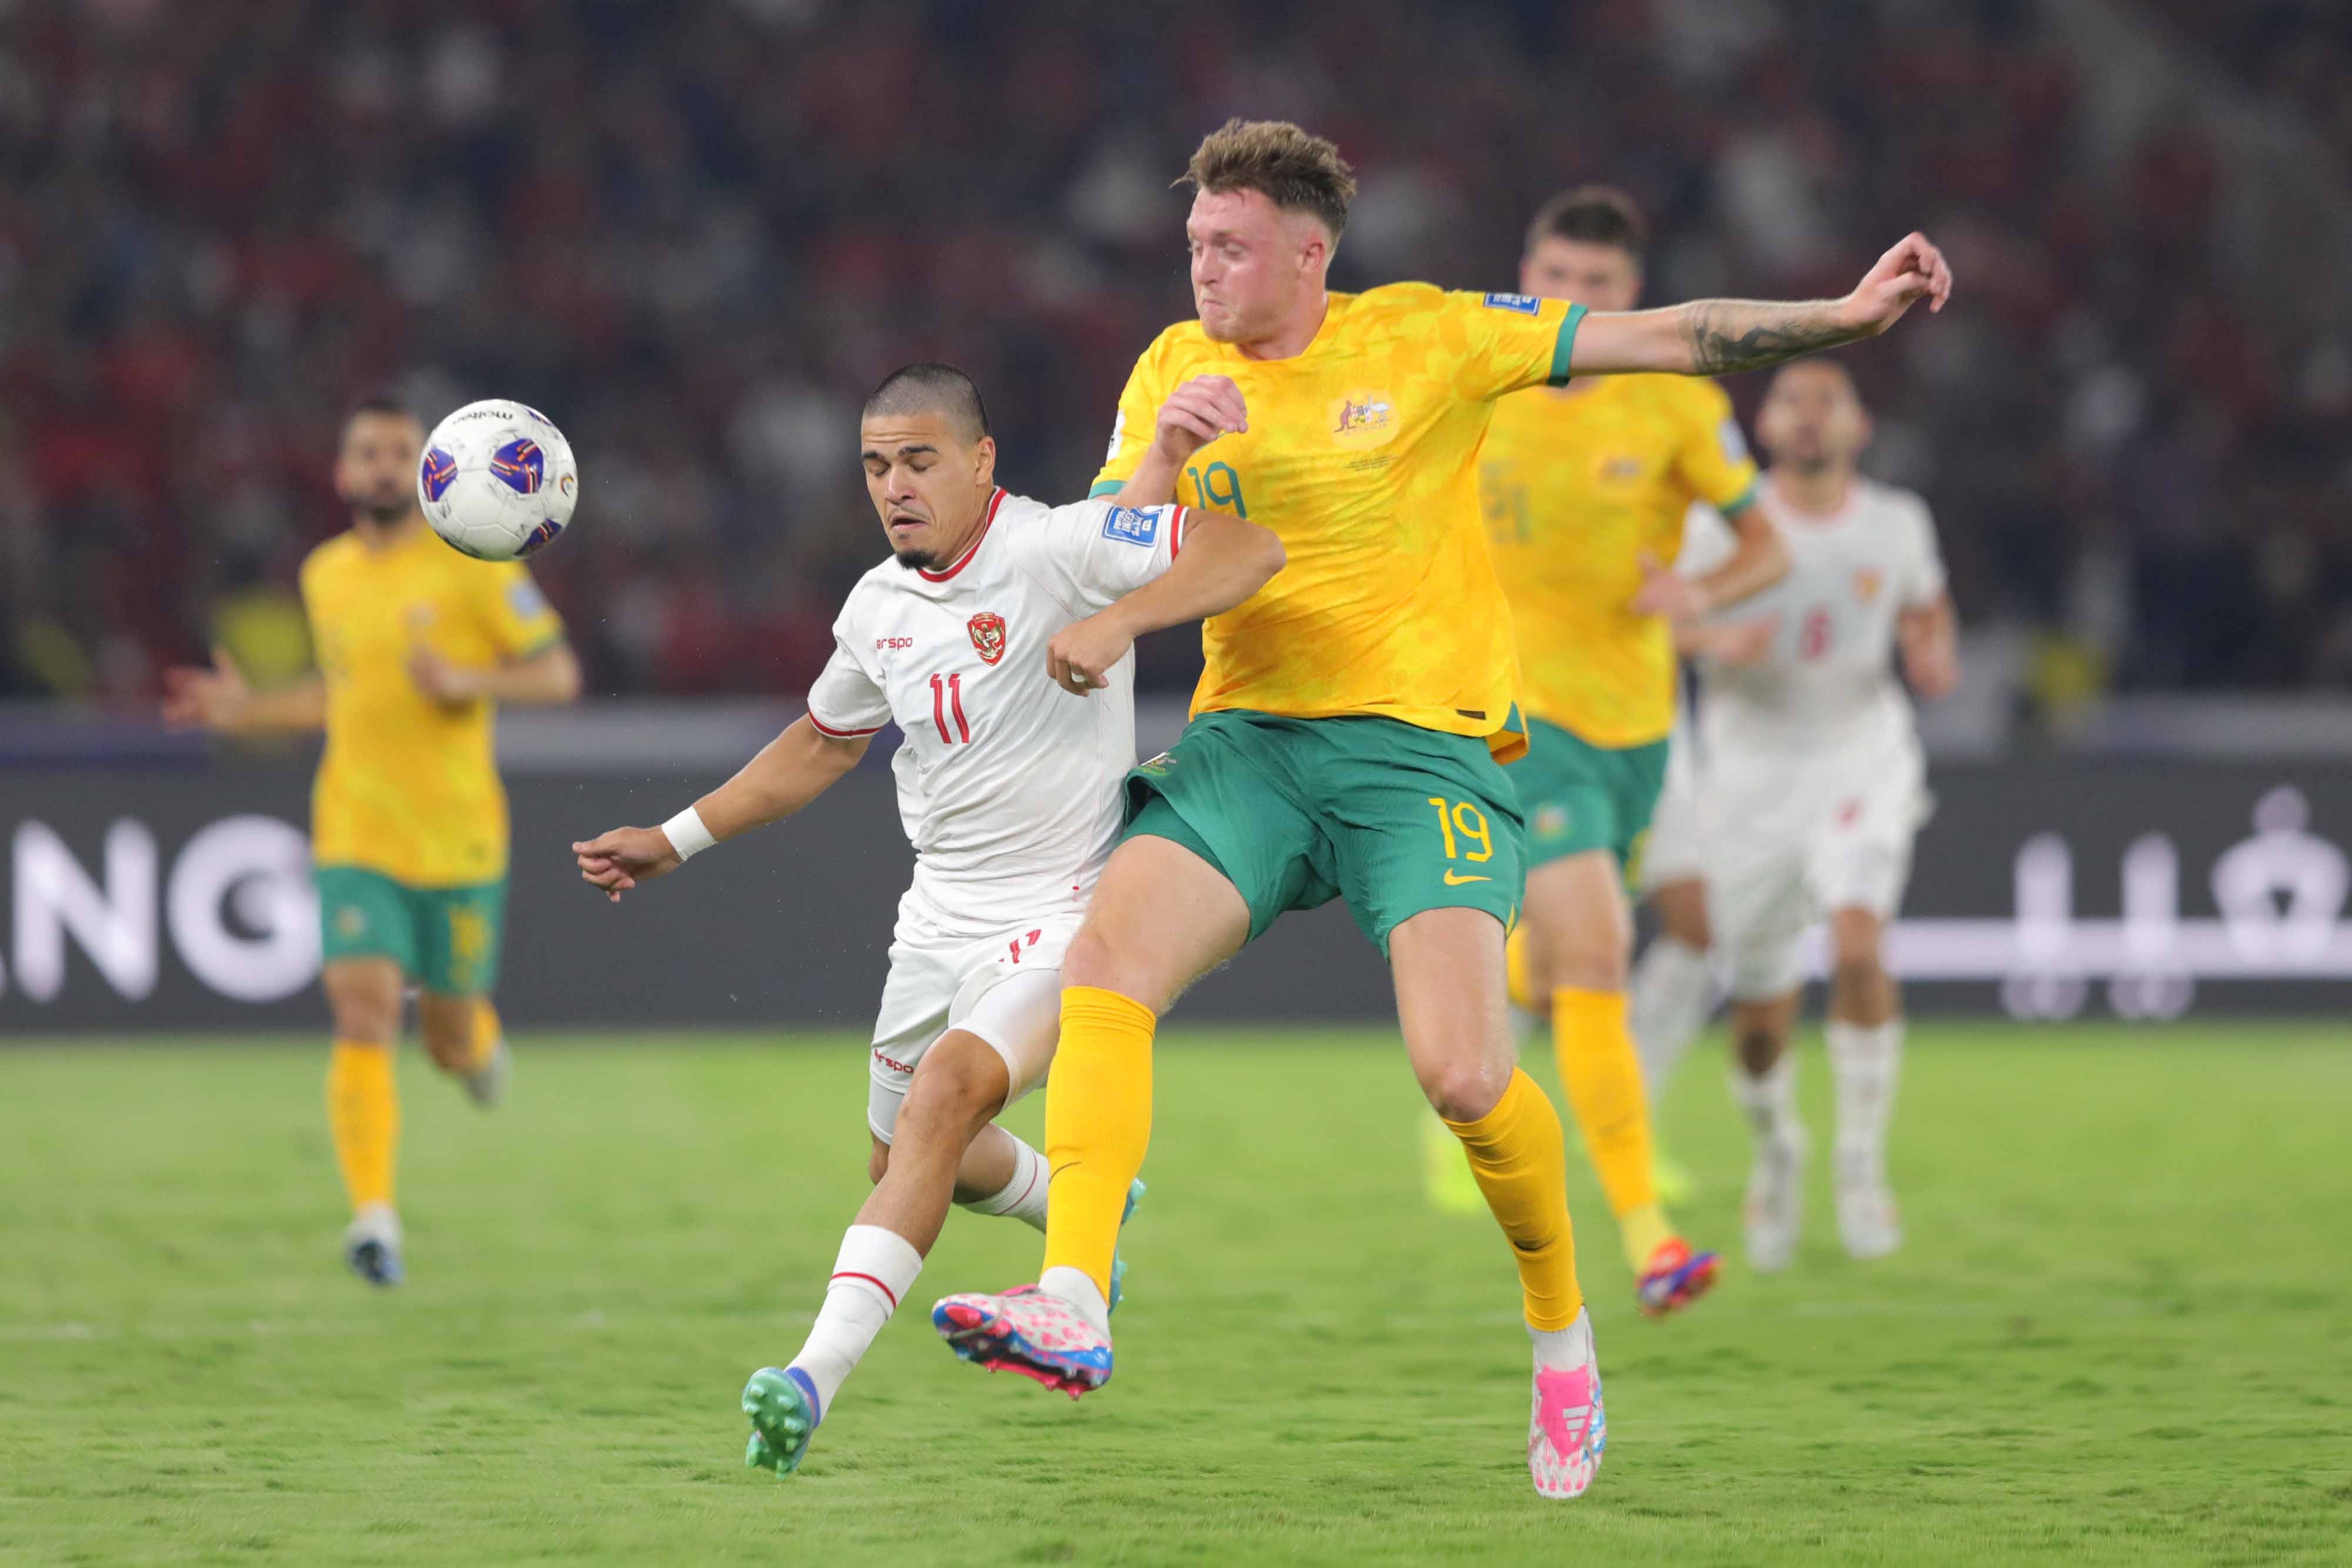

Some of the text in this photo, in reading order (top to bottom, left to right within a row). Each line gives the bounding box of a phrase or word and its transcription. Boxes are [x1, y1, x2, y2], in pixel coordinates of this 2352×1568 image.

[1186, 461, 1246, 519] 19
[876, 637, 913, 651] erspo
[930, 673, 970, 744] 11
[1428, 797, 1494, 863] 19
[0, 813, 322, 1005] NG
